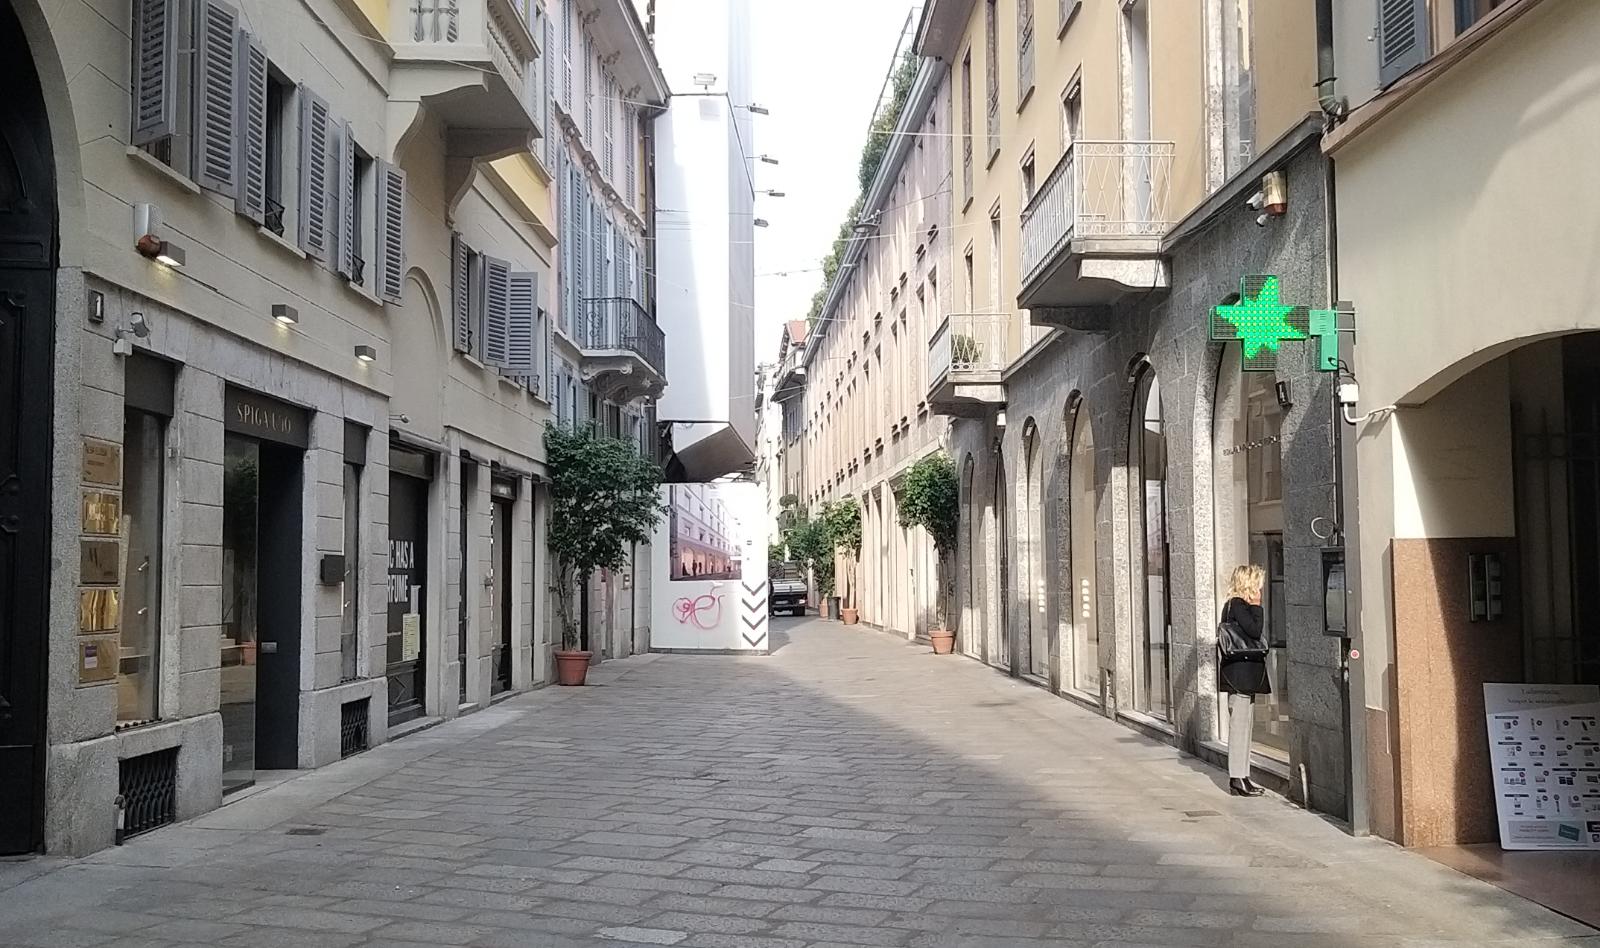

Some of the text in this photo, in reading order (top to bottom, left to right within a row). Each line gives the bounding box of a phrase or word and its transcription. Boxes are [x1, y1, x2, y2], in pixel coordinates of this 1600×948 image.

[96, 295, 101, 317] 1
[395, 540, 409, 570] HAS
[409, 541, 415, 569] A
